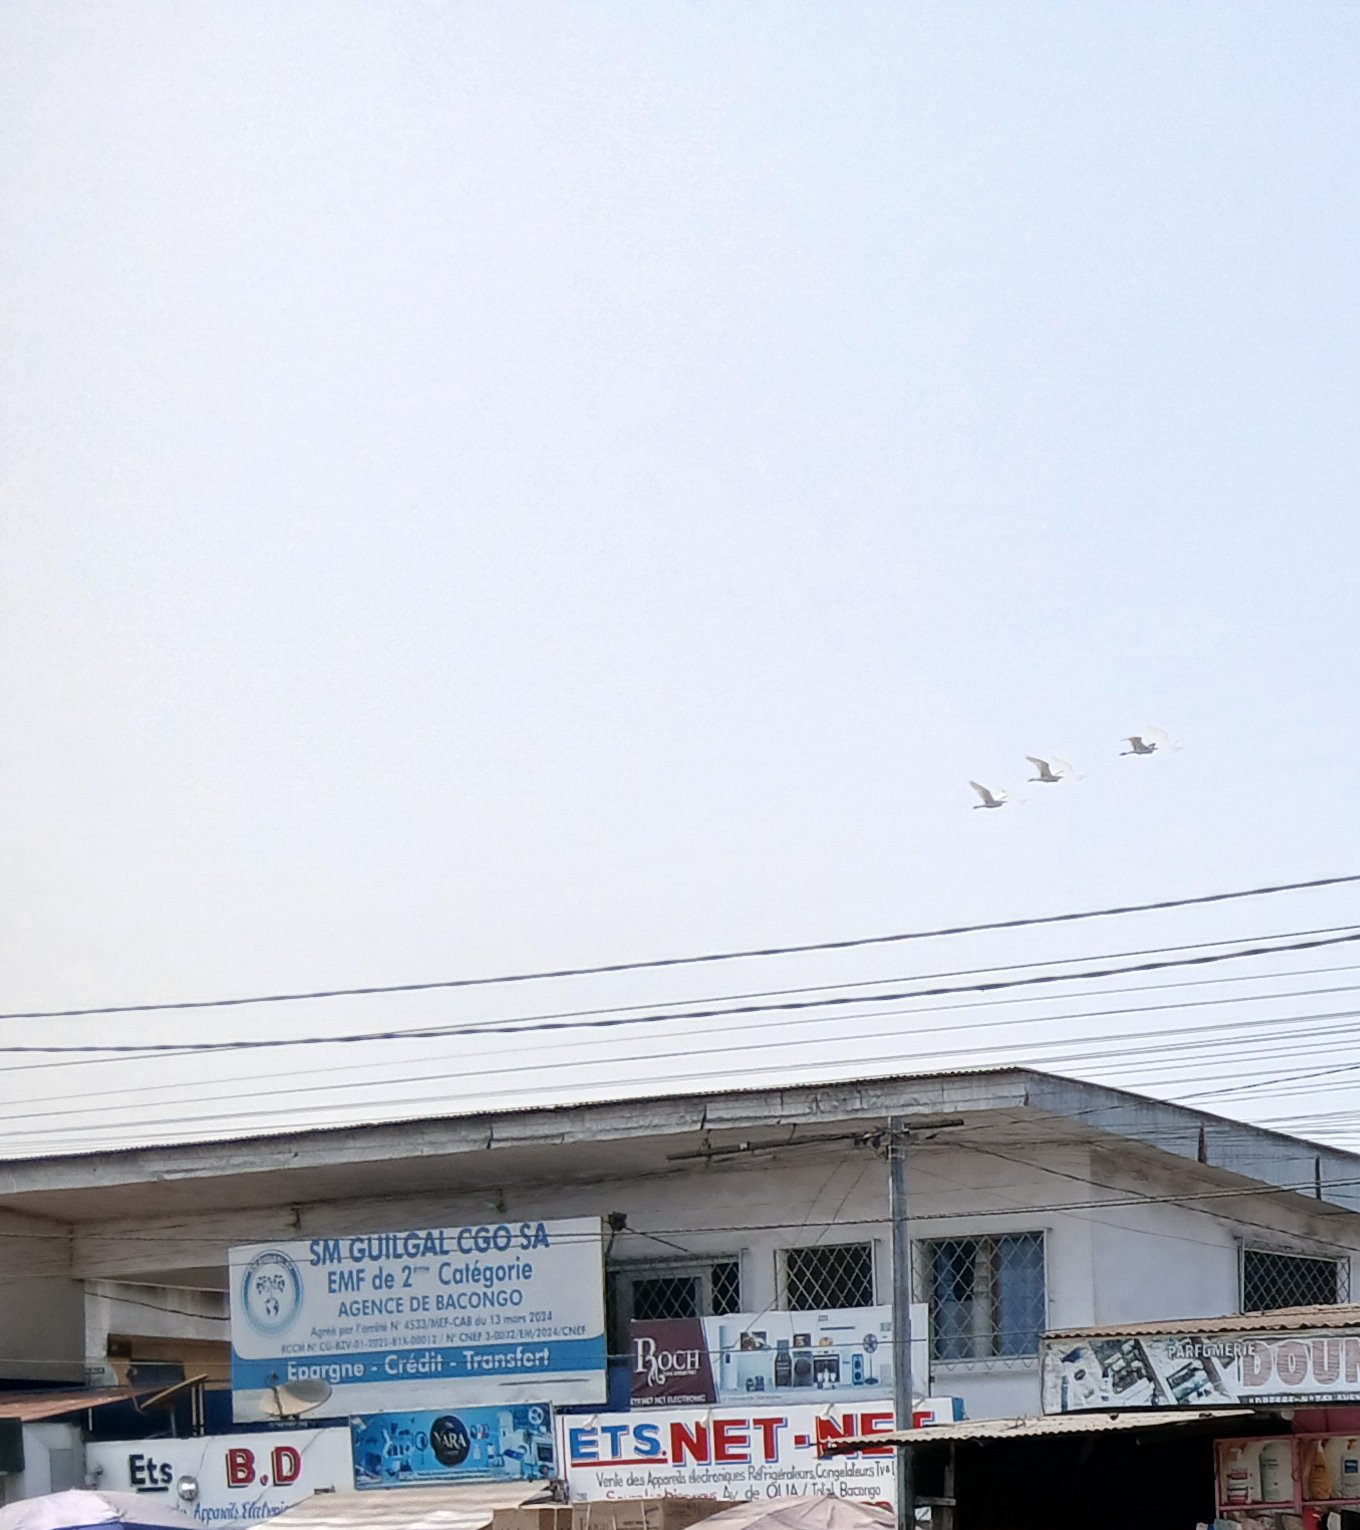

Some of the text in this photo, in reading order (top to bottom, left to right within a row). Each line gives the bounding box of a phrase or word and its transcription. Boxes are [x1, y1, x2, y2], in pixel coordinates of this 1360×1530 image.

[309, 1221, 551, 1266] SM GUILGAL CGO SA
[326, 1268, 367, 1295] EMF
[370, 1265, 396, 1291] de
[437, 1256, 534, 1289] Catégorie
[338, 1288, 523, 1318] AGENCE DE BACONGO
[474, 1314, 487, 1326] du
[490, 1314, 502, 1326] 13
[503, 1314, 527, 1325] mars
[286, 1360, 365, 1384] Epargne
[384, 1350, 444, 1375] Crédit
[463, 1345, 550, 1371] Transfert
[632, 1337, 702, 1388] ROCH
[1168, 1340, 1256, 1360] PARFUMERIE
[129, 1454, 173, 1485] Ets
[225, 1445, 301, 1489] B.D
[596, 1471, 624, 1488] Vente
[626, 1471, 646, 1487] des
[744, 1483, 760, 1500] de
[839, 1481, 881, 1498] Bacongo
